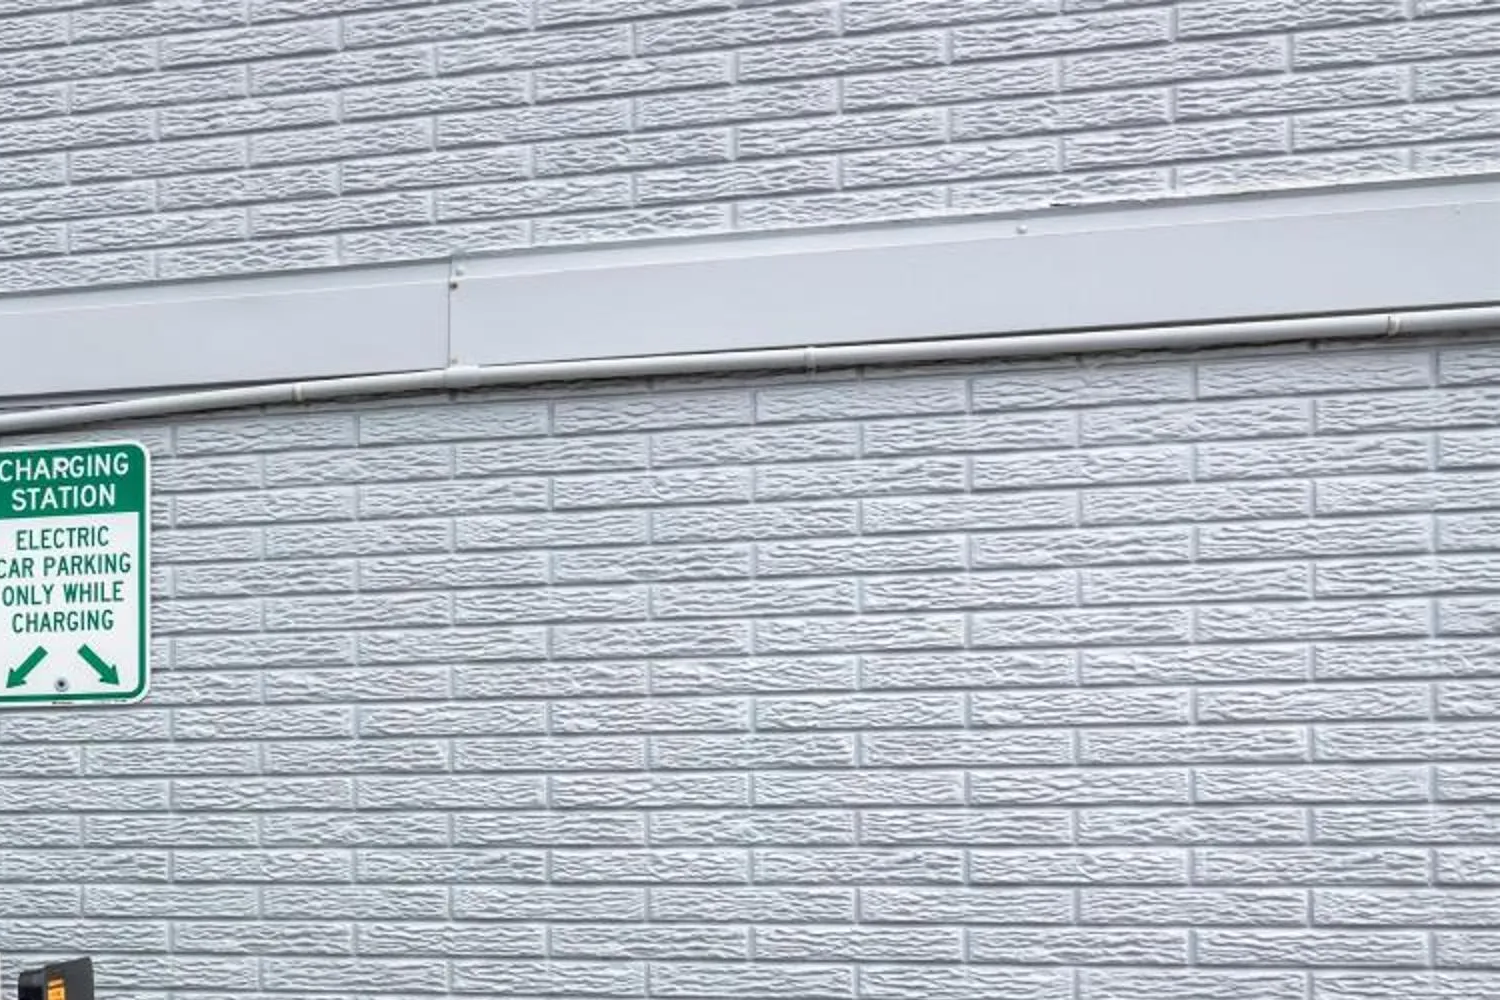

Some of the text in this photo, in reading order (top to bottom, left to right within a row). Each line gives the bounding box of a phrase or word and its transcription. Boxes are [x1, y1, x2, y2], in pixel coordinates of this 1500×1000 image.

[12, 484, 116, 511] STATION
[16, 526, 109, 551] ELECTRIC
[43, 553, 131, 577] PARKING
[2, 581, 124, 607] ONLY WHILE
[12, 610, 114, 633] CHARGING
